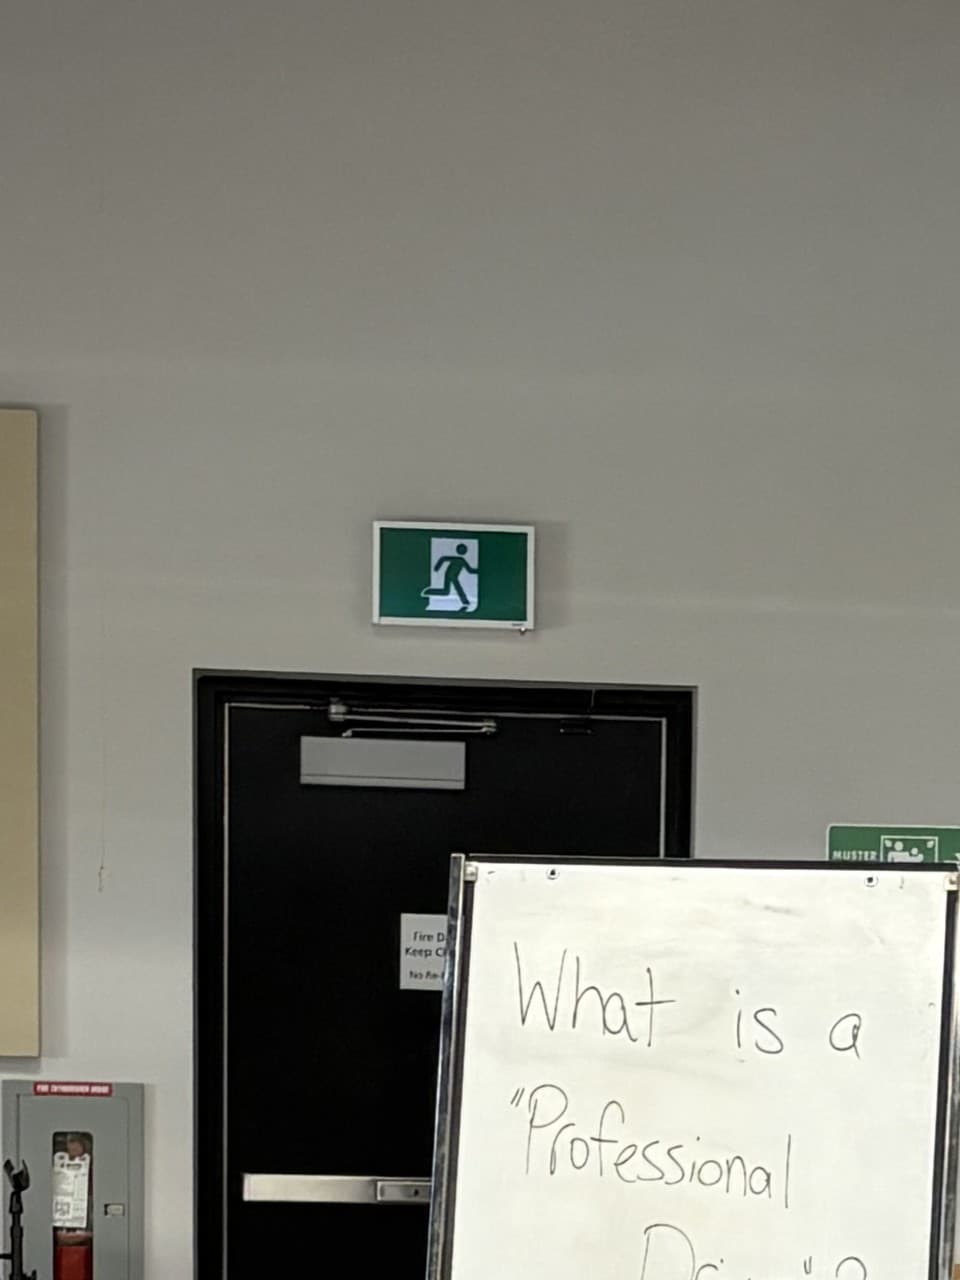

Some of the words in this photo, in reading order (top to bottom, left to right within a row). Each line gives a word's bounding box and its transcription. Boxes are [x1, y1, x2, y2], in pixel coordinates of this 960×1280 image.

[833, 850, 878, 862] MUSTER
[413, 931, 434, 942] Fire
[405, 947, 432, 958] Keep
[513, 941, 677, 1048] What
[735, 988, 785, 1055] is
[828, 1012, 862, 1059] a
[509, 1083, 792, 1209] "Professional
